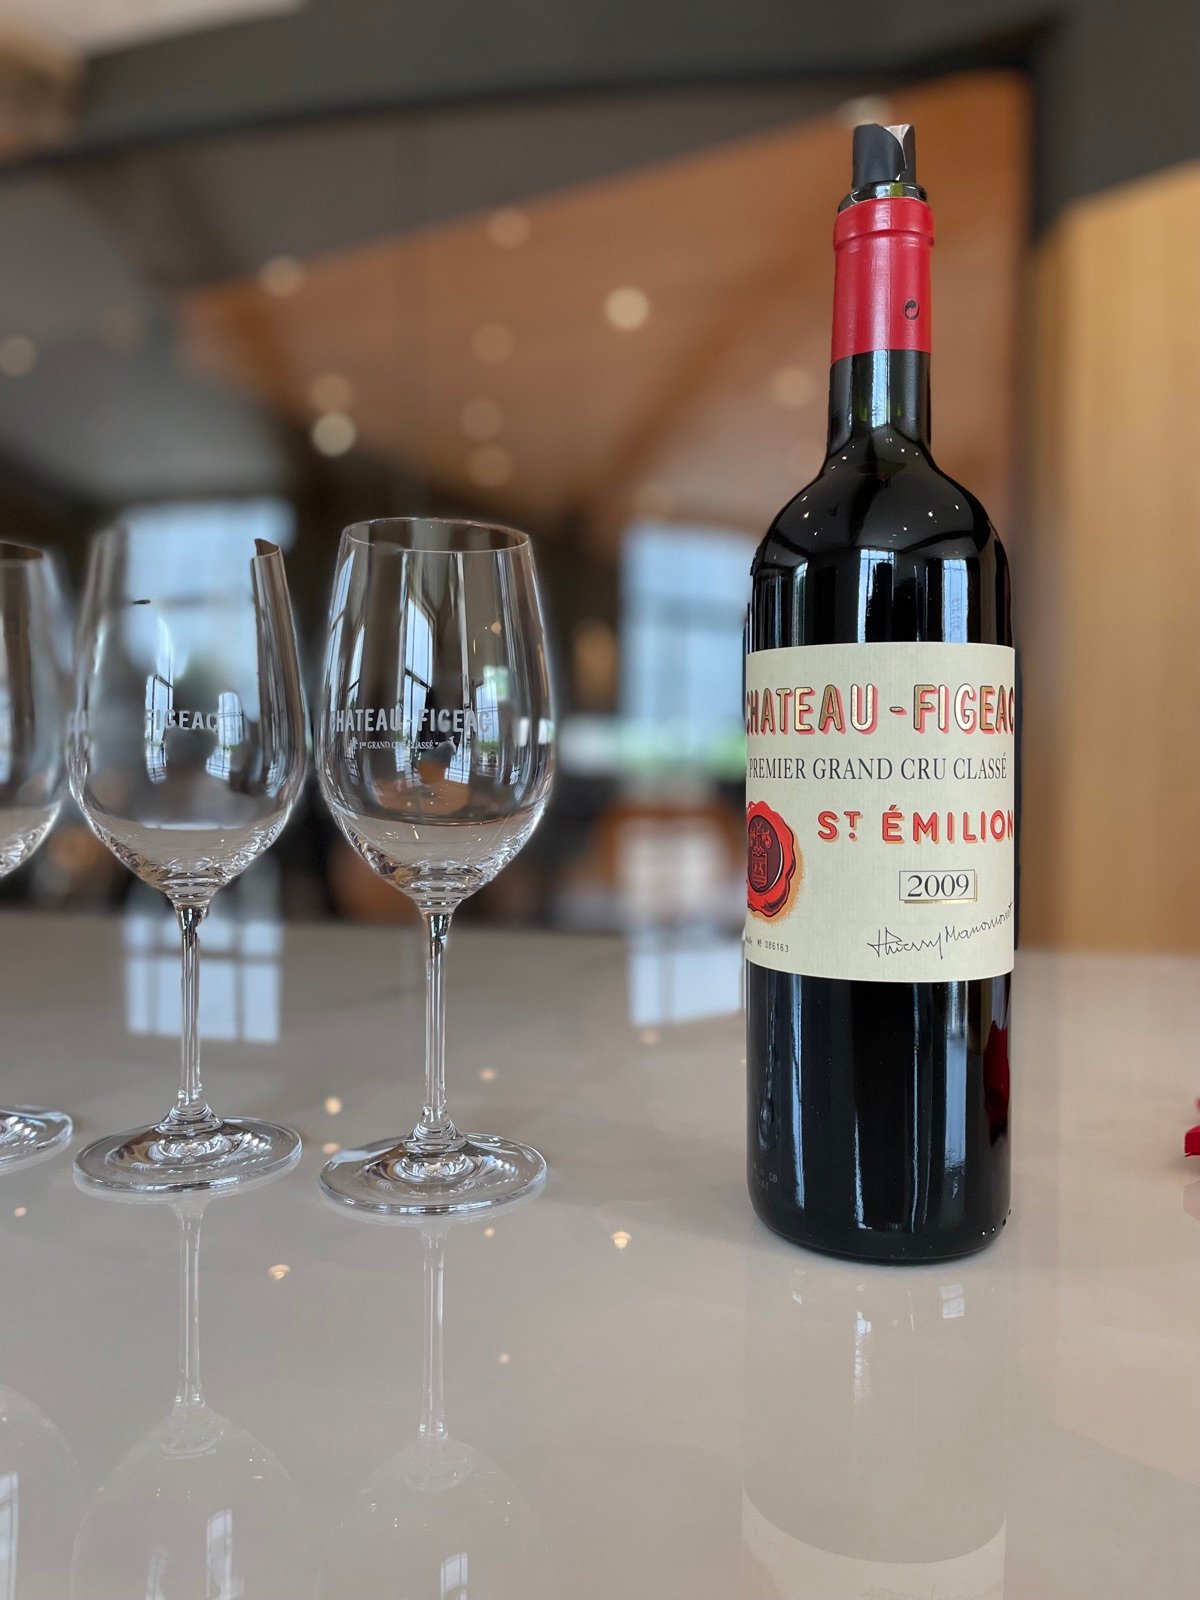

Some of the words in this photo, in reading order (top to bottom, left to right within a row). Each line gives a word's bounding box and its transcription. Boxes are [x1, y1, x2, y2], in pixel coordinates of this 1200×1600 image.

[749, 758, 806, 779] PREMIER
[812, 757, 893, 780] GRAND
[900, 757, 946, 780] CRU
[953, 752, 1007, 779] CLASSÉ
[907, 873, 970, 898] 2009
